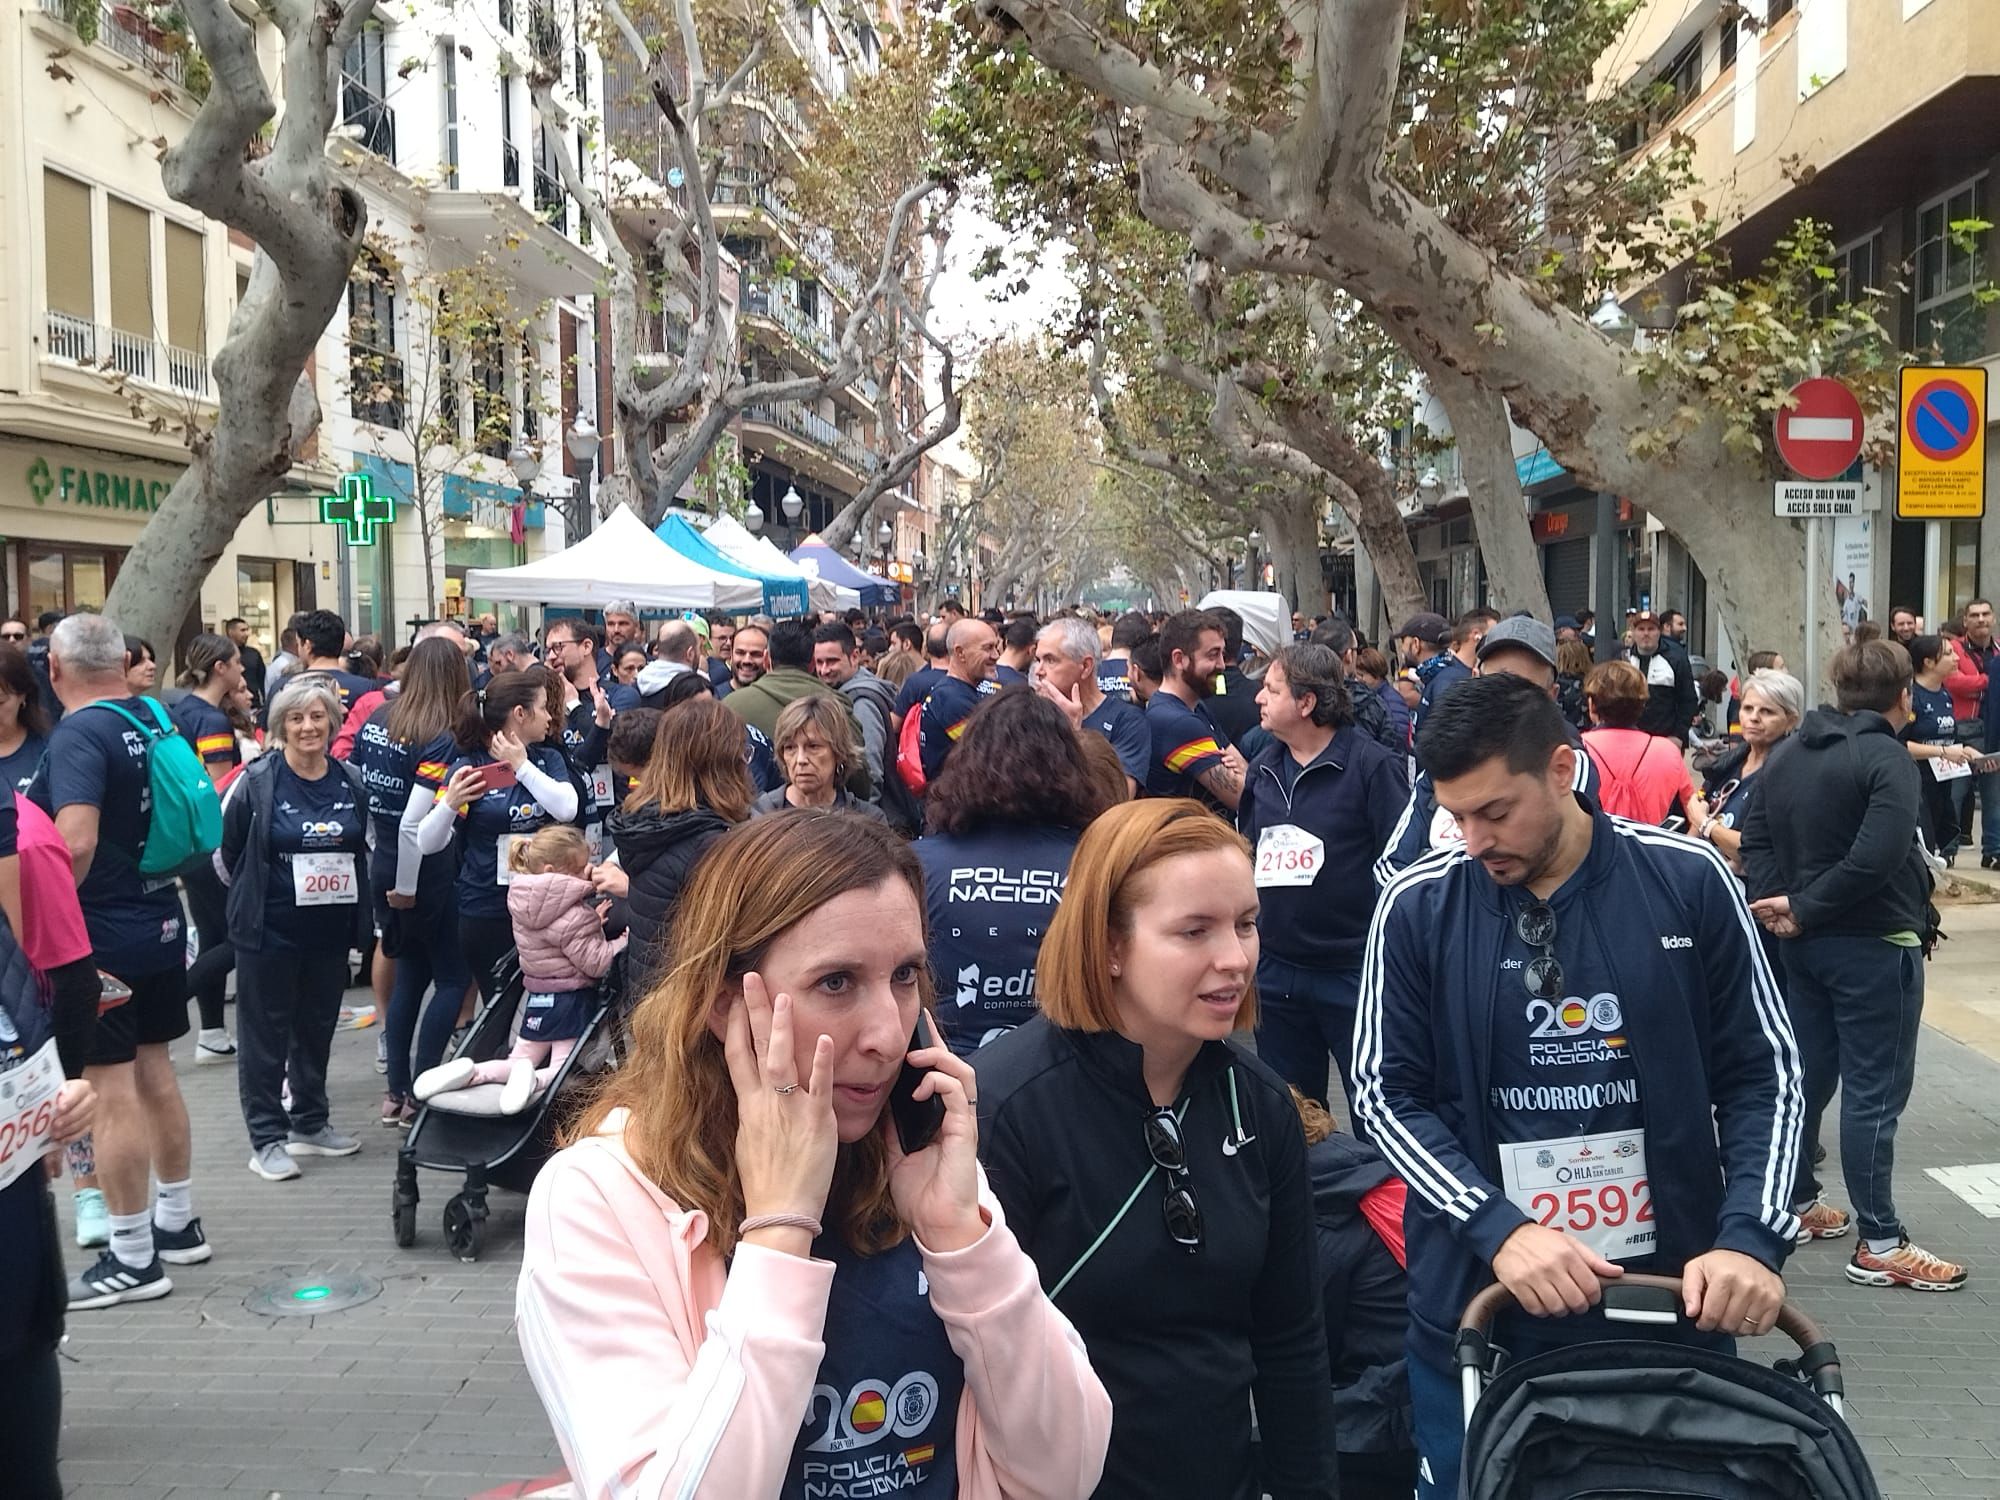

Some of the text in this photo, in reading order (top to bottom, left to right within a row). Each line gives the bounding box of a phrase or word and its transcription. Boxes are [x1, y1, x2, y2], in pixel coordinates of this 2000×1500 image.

[60, 466, 171, 513] FARMAC
[1785, 488, 1856, 500] ACCESO SOLO VADO
[1813, 503, 1832, 513] SOLS
[302, 821, 343, 837] 200
[1262, 849, 1314, 871] 2136
[305, 875, 350, 893] 2067
[1526, 992, 1623, 1038] 200
[1529, 1039, 1610, 1054] POLICIA
[1530, 1049, 1631, 1066] NACIONAL
[1574, 1166, 1592, 1180] HLA
[1531, 1180, 1656, 1233] 2592
[804, 1452, 908, 1479] POLICIA
[804, 1467, 928, 1500] NACIONAL
